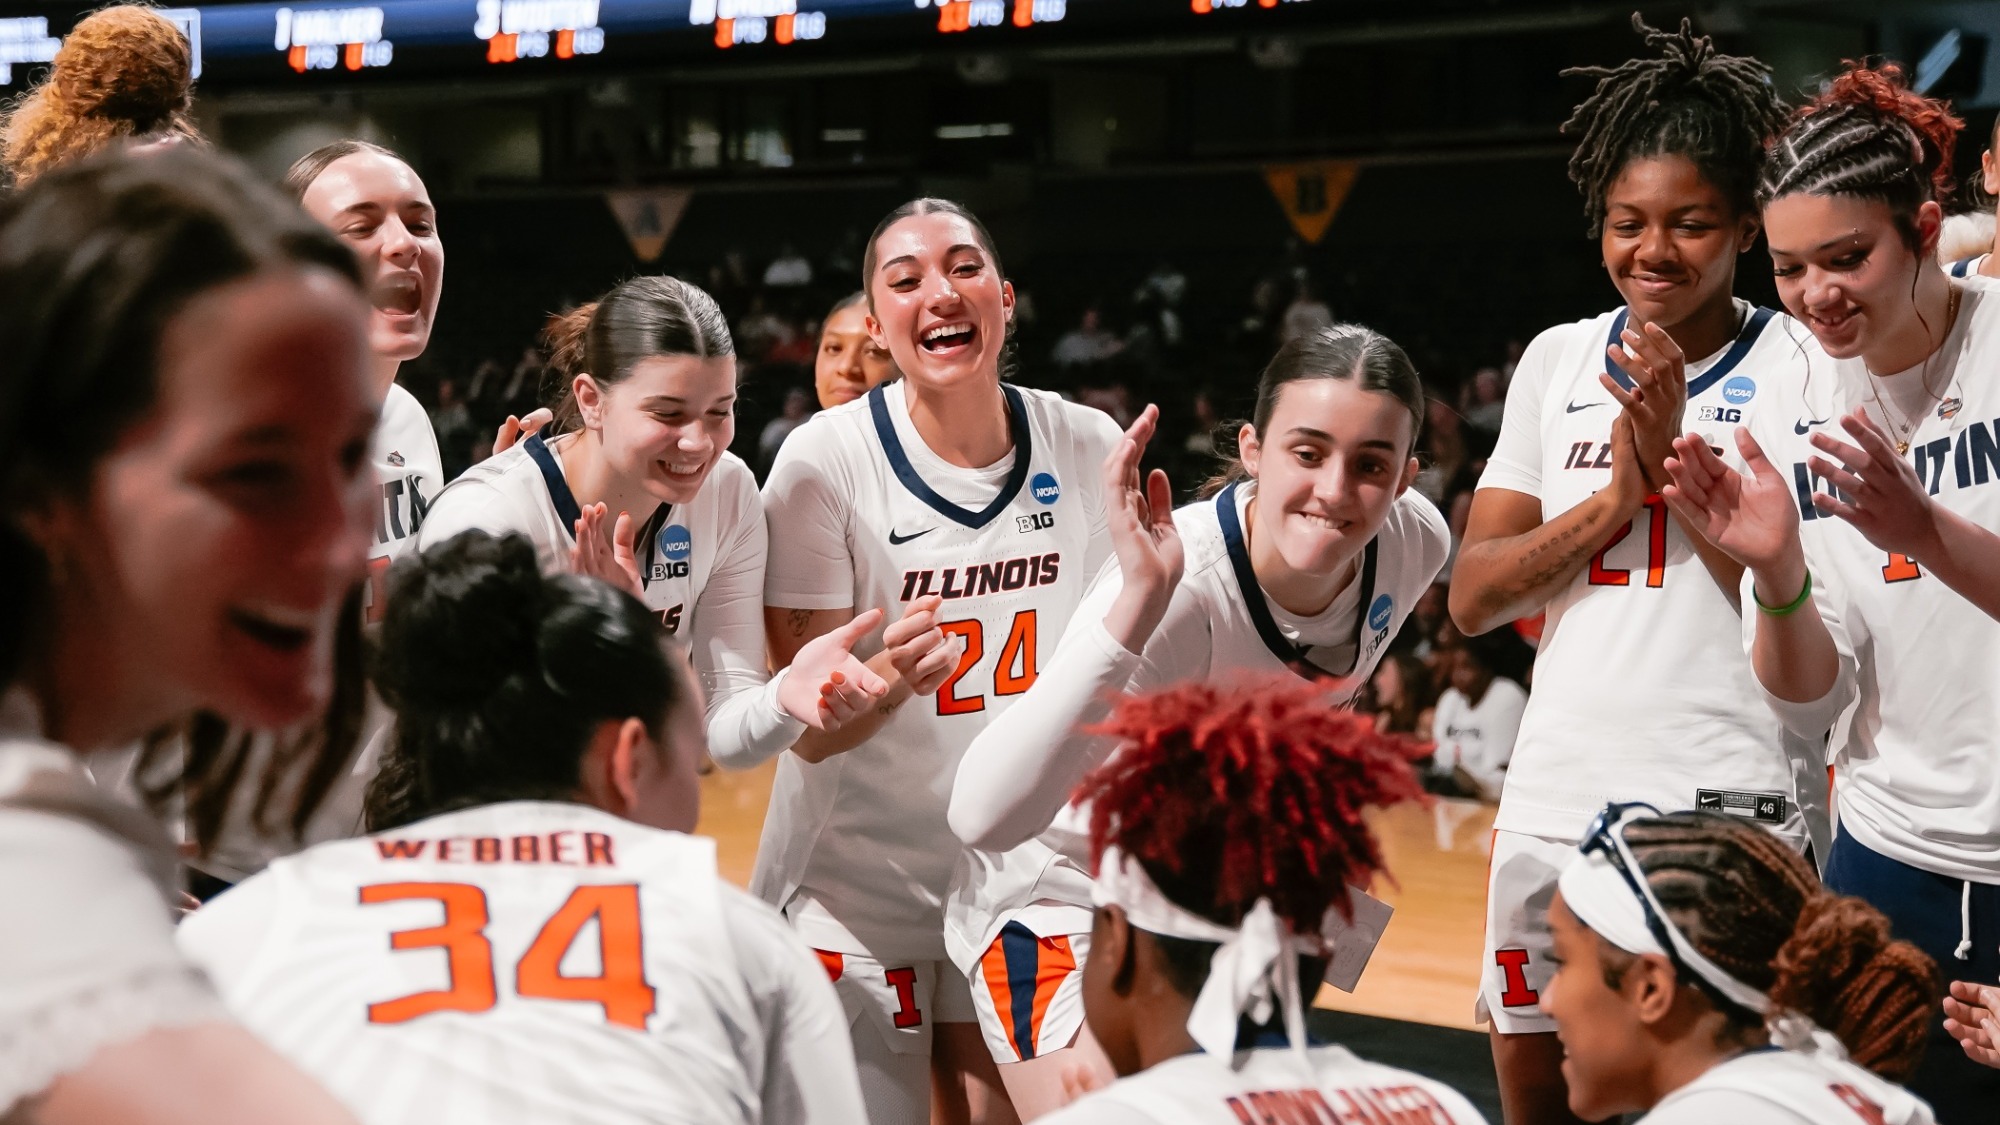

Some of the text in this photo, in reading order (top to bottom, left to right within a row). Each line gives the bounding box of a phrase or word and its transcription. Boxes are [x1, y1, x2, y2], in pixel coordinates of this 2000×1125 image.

[1725, 387, 1752, 398] NCAA
[1036, 485, 1060, 498] NCAA
[665, 541, 690, 553] NCAA
[900, 552, 1060, 602] ILLINOIS
[936, 608, 1039, 717] 24
[1761, 803, 1774, 814] 46
[374, 830, 617, 868] WEBBER
[358, 881, 657, 1032] 34
